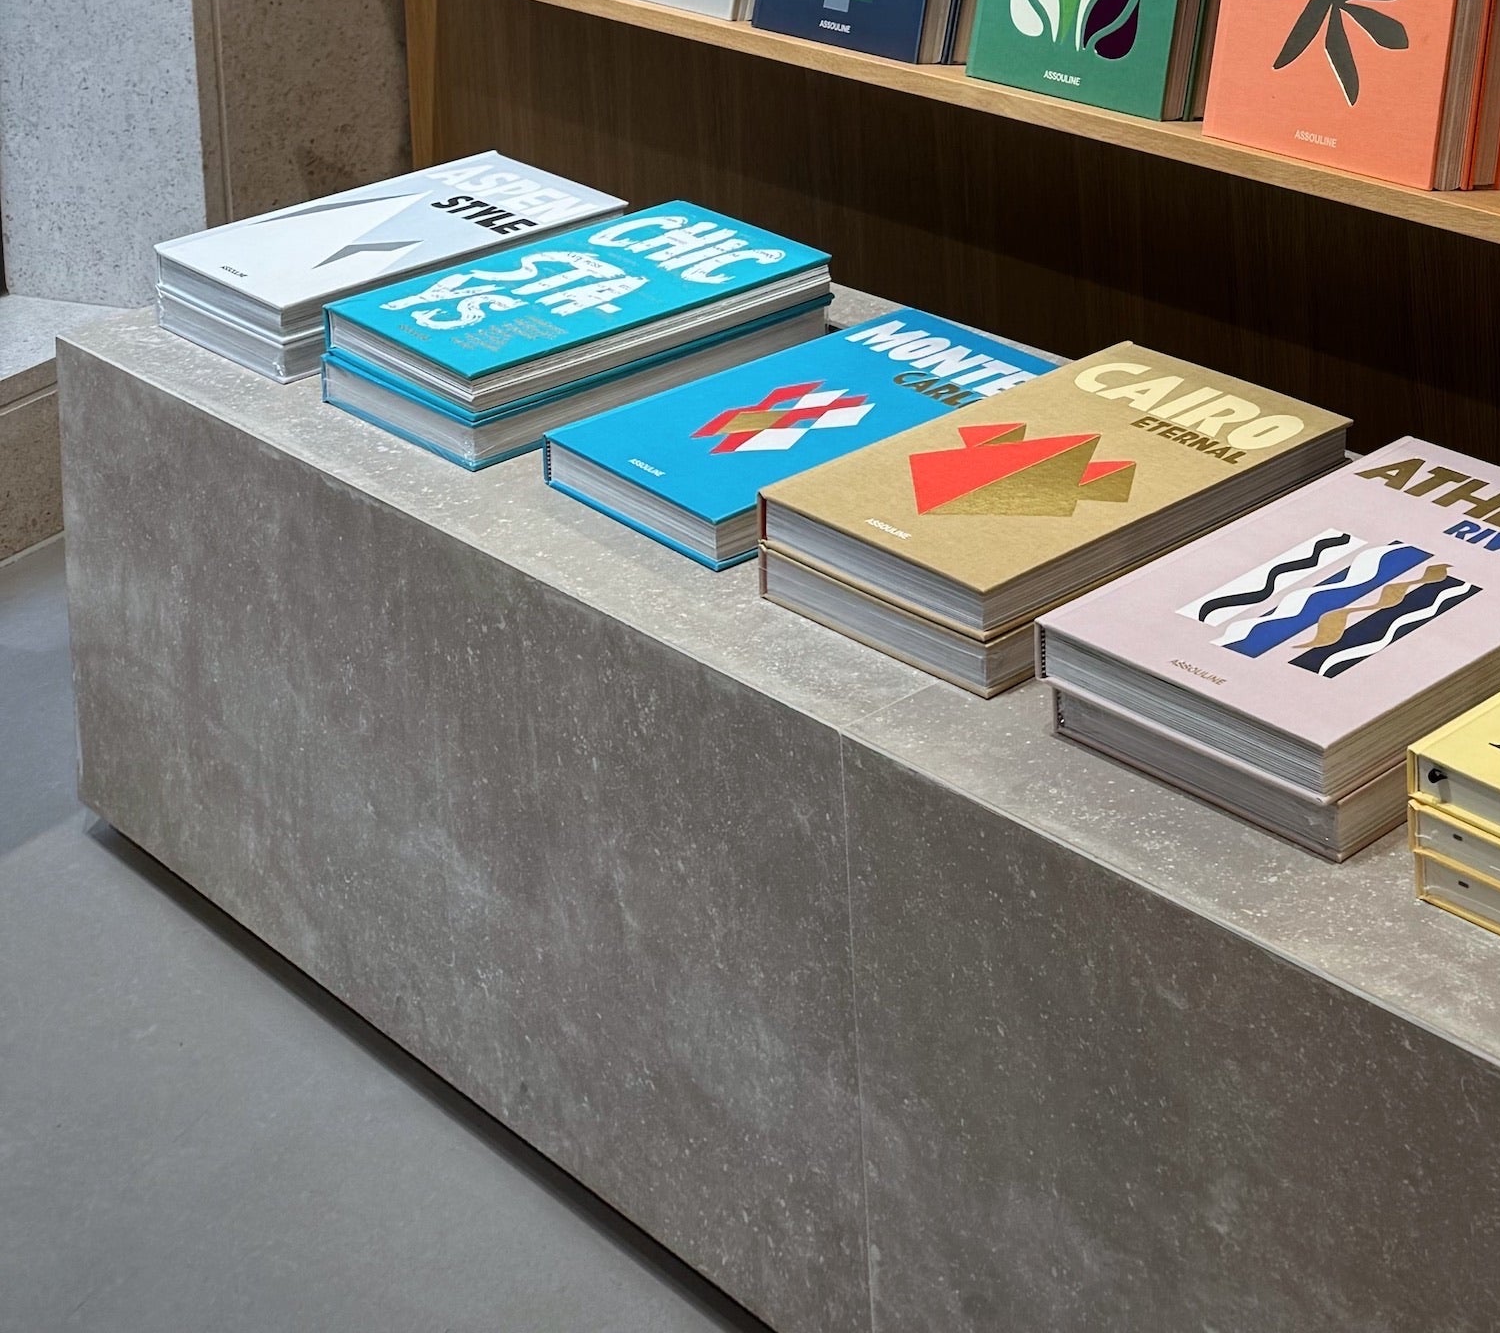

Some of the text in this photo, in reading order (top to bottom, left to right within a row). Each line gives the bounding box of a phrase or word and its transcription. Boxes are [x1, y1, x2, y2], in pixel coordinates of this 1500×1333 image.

[819, 20, 851, 34] ASSOULINE
[1043, 69, 1081, 86] ASSOULINE
[1294, 129, 1338, 148] ASSOULINE
[427, 164, 600, 224] ASPEN
[431, 195, 538, 235] STYLE
[588, 215, 786, 284] CHIC
[844, 320, 1038, 397] MONTE
[1073, 362, 1305, 450] CAIRO
[1129, 416, 1248, 465] ETERNAL
[628, 457, 667, 477] ASSOULINE
[865, 517, 912, 540] ASSOULINE
[1169, 657, 1227, 687] ASSOULINE
